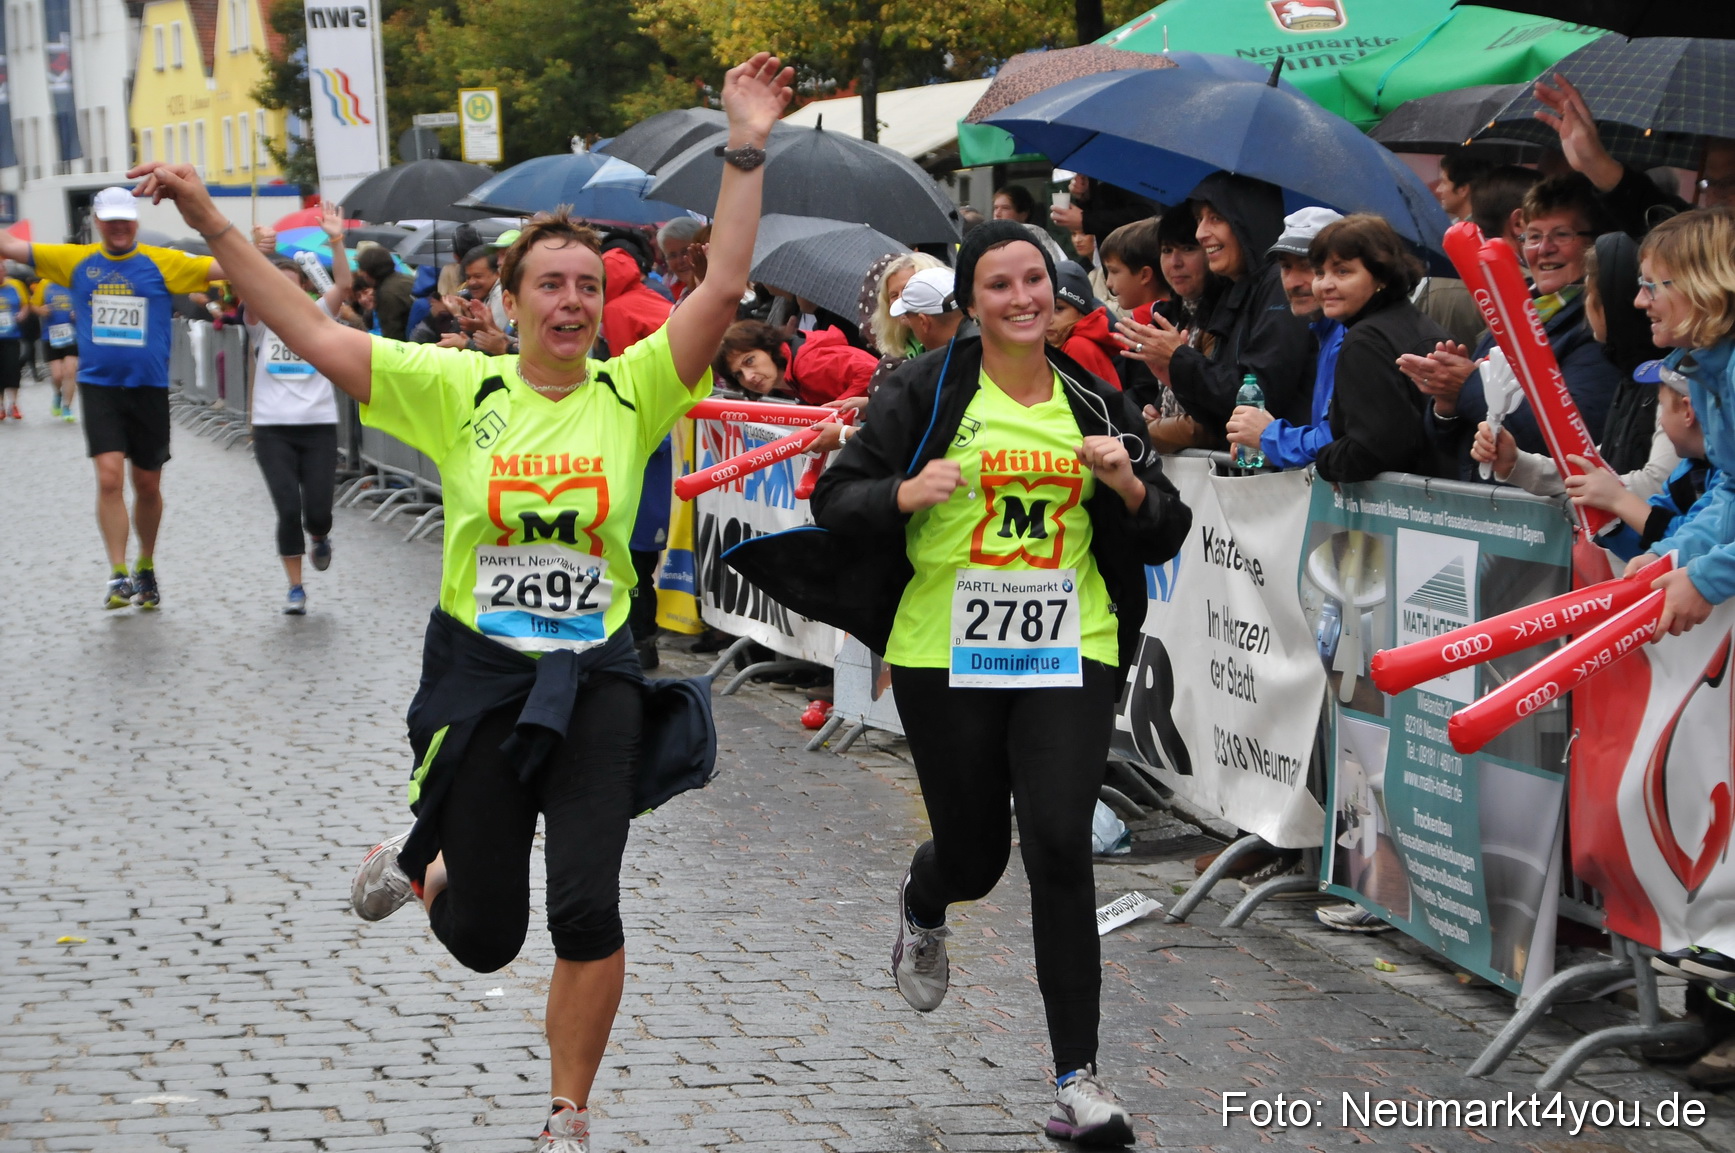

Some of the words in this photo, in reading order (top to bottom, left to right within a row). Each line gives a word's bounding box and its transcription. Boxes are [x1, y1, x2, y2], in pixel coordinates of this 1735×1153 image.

[1300, 21, 1331, 30] 1628
[97, 307, 139, 326] 2720
[1548, 367, 1573, 408] BKK
[760, 414, 785, 424] BKK
[775, 438, 803, 457] Audi
[1567, 411, 1595, 458] Audi
[490, 452, 604, 477] Müller
[748, 454, 774, 467] BKK
[979, 449, 1084, 475] Müller
[518, 509, 580, 545] M
[996, 495, 1052, 539] M
[1432, 510, 1444, 526] und
[1522, 523, 1546, 547] Bayern
[480, 555, 525, 567] PARTL
[528, 555, 581, 574] Neumarkt
[491, 569, 600, 612] 2692
[956, 580, 999, 593] PARTL
[1002, 581, 1058, 593] Neumarkt
[965, 598, 1068, 642] 2787
[1561, 593, 1613, 623] Audi
[530, 616, 559, 634] Iris
[1207, 599, 1220, 638] Im
[1222, 604, 1270, 655] Herzen
[1403, 609, 1431, 637] MATHI
[1510, 612, 1557, 640] BKK
[1614, 617, 1658, 655] Audi
[971, 652, 1060, 673] Dominique
[1572, 648, 1612, 681] BKK
[1210, 651, 1226, 690] der
[1227, 655, 1257, 704] Stadt
[1405, 714, 1422, 737] 92318
[1413, 806, 1453, 838] Trockenbau
[1436, 890, 1482, 926] Sanierungen
